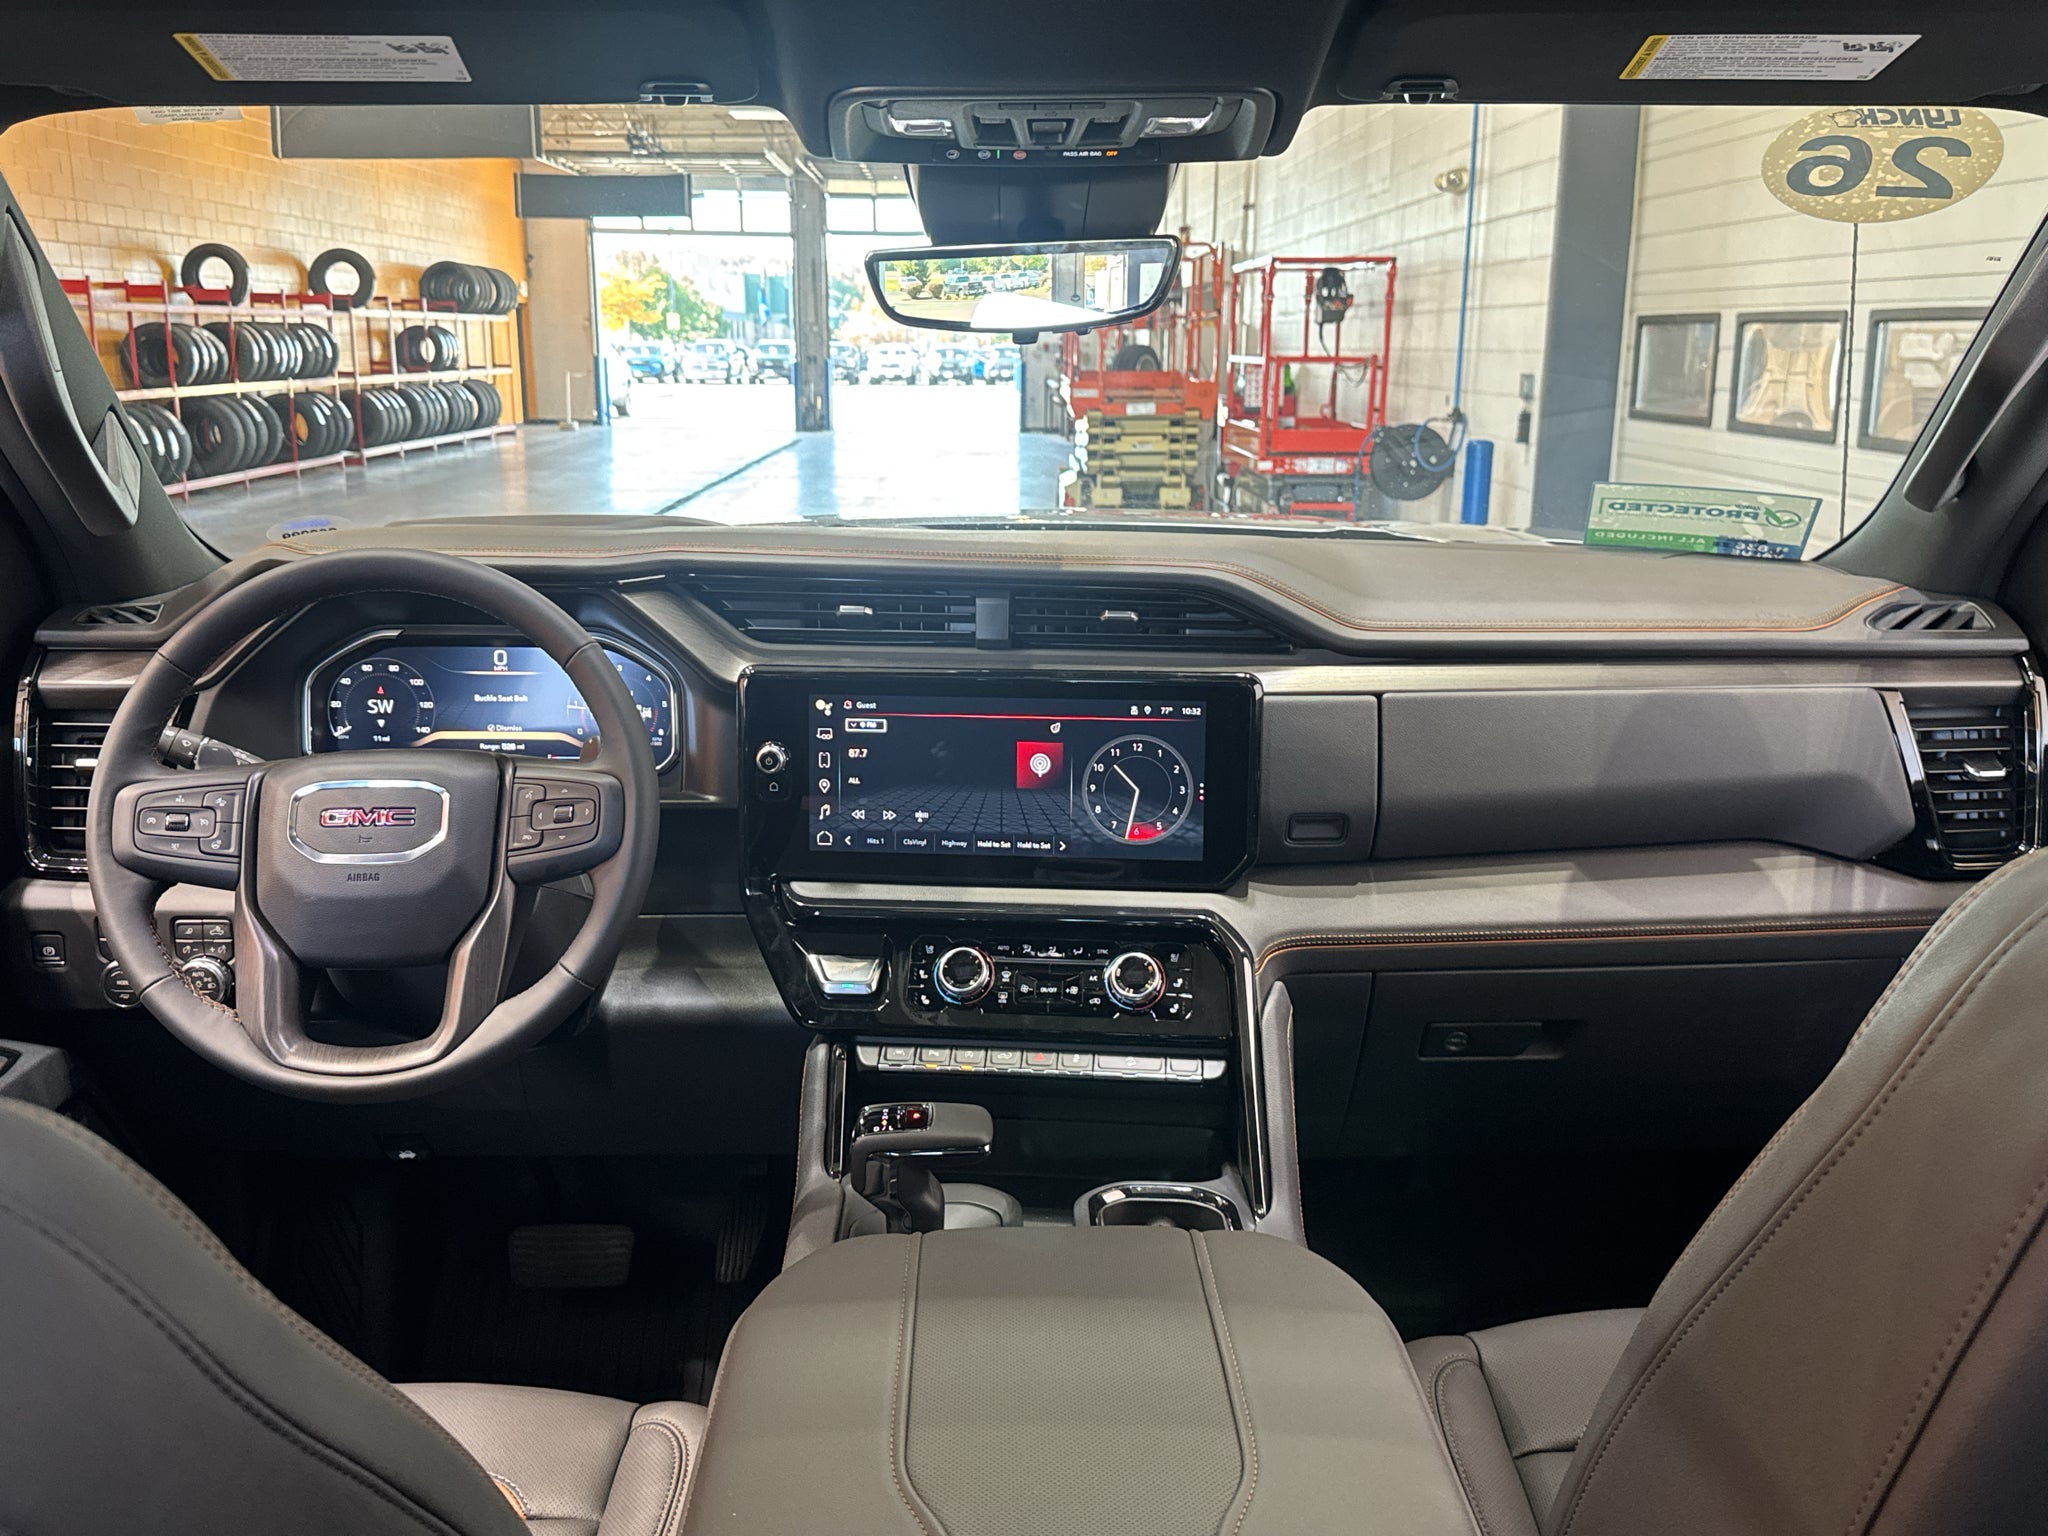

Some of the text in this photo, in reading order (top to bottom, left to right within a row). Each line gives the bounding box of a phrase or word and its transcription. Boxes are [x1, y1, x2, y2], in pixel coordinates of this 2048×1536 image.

[493, 649, 508, 666] 0
[361, 664, 373, 672] 60
[340, 677, 352, 685] 40
[409, 678, 425, 686] 100
[498, 694, 514, 702] Seat
[330, 700, 342, 708] 20
[366, 698, 395, 714] SW
[419, 701, 434, 709] 120
[856, 701, 877, 710] Guest
[1181, 707, 1202, 716] 10:32
[415, 726, 431, 734] 140
[1132, 742, 1143, 752] 12
[848, 748, 868, 758] 87.7
[1110, 748, 1121, 757] 11
[1157, 749, 1162, 758] 1
[1093, 763, 1104, 772] 10
[1173, 765, 1180, 774] 2
[848, 776, 861, 785] ALL
[1089, 783, 1096, 792] 9
[1179, 785, 1185, 794] 3
[1094, 805, 1101, 814] 8
[1171, 806, 1178, 815] 4
[320, 807, 416, 828] GMC
[1111, 820, 1117, 829] 7
[1156, 821, 1162, 831] 5
[1133, 826, 1140, 836] 6
[902, 838, 927, 847] ClsVinyl
[941, 839, 968, 849] Highway
[977, 840, 1011, 849] Hold to Set
[1016, 841, 1051, 850] Hold to Set
[346, 872, 380, 882] AIRBAG
